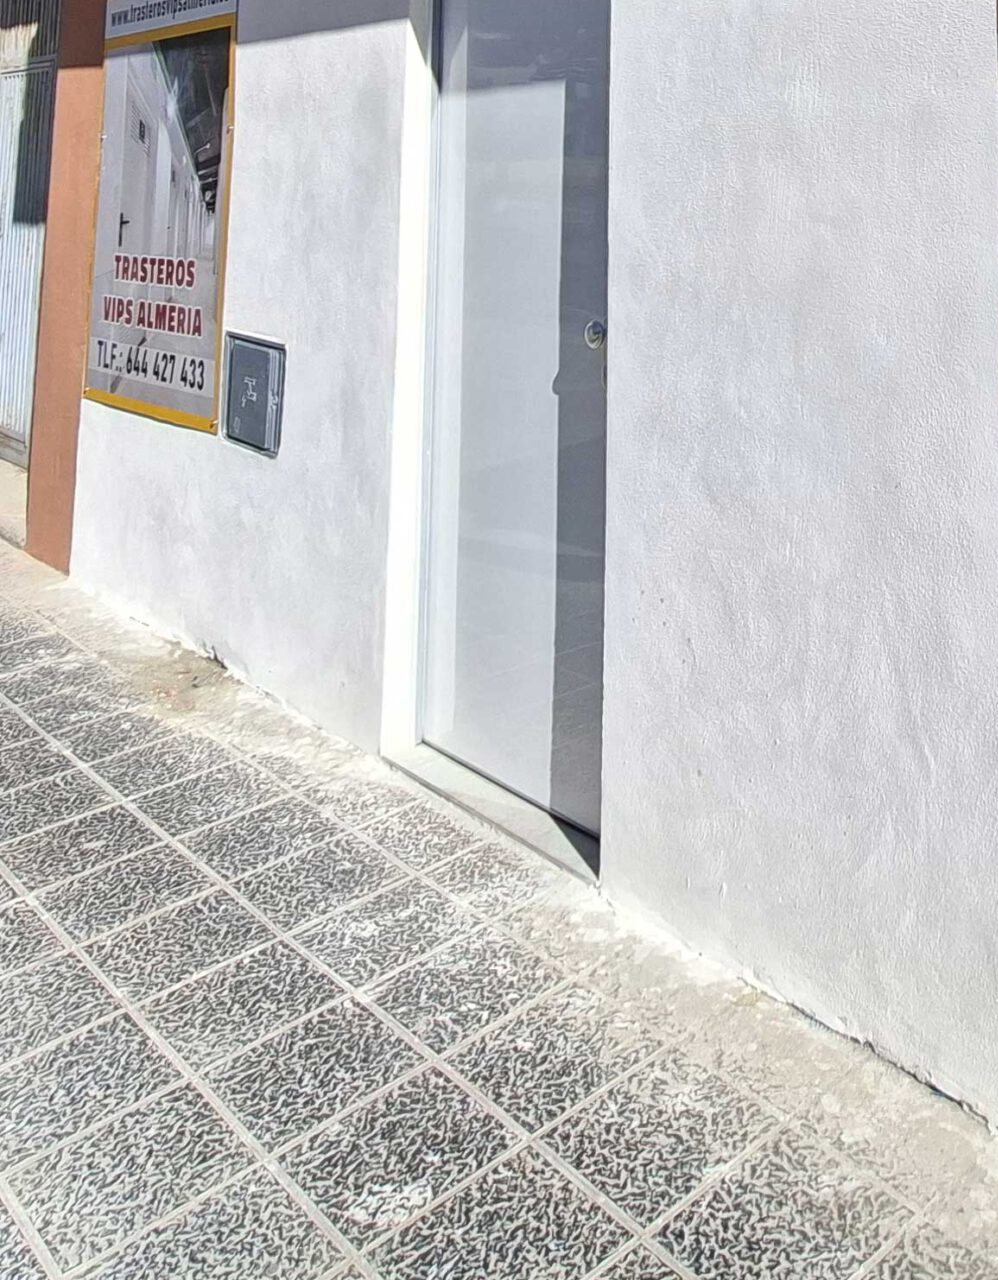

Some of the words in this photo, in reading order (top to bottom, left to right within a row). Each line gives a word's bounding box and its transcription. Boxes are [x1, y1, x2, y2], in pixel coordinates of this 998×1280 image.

[115, 255, 195, 287] TRASTEROS
[104, 296, 133, 325] VIPS
[137, 302, 202, 336] ALMERIA
[126, 346, 148, 378] 644
[153, 352, 176, 384] 427
[180, 357, 205, 390] 433
